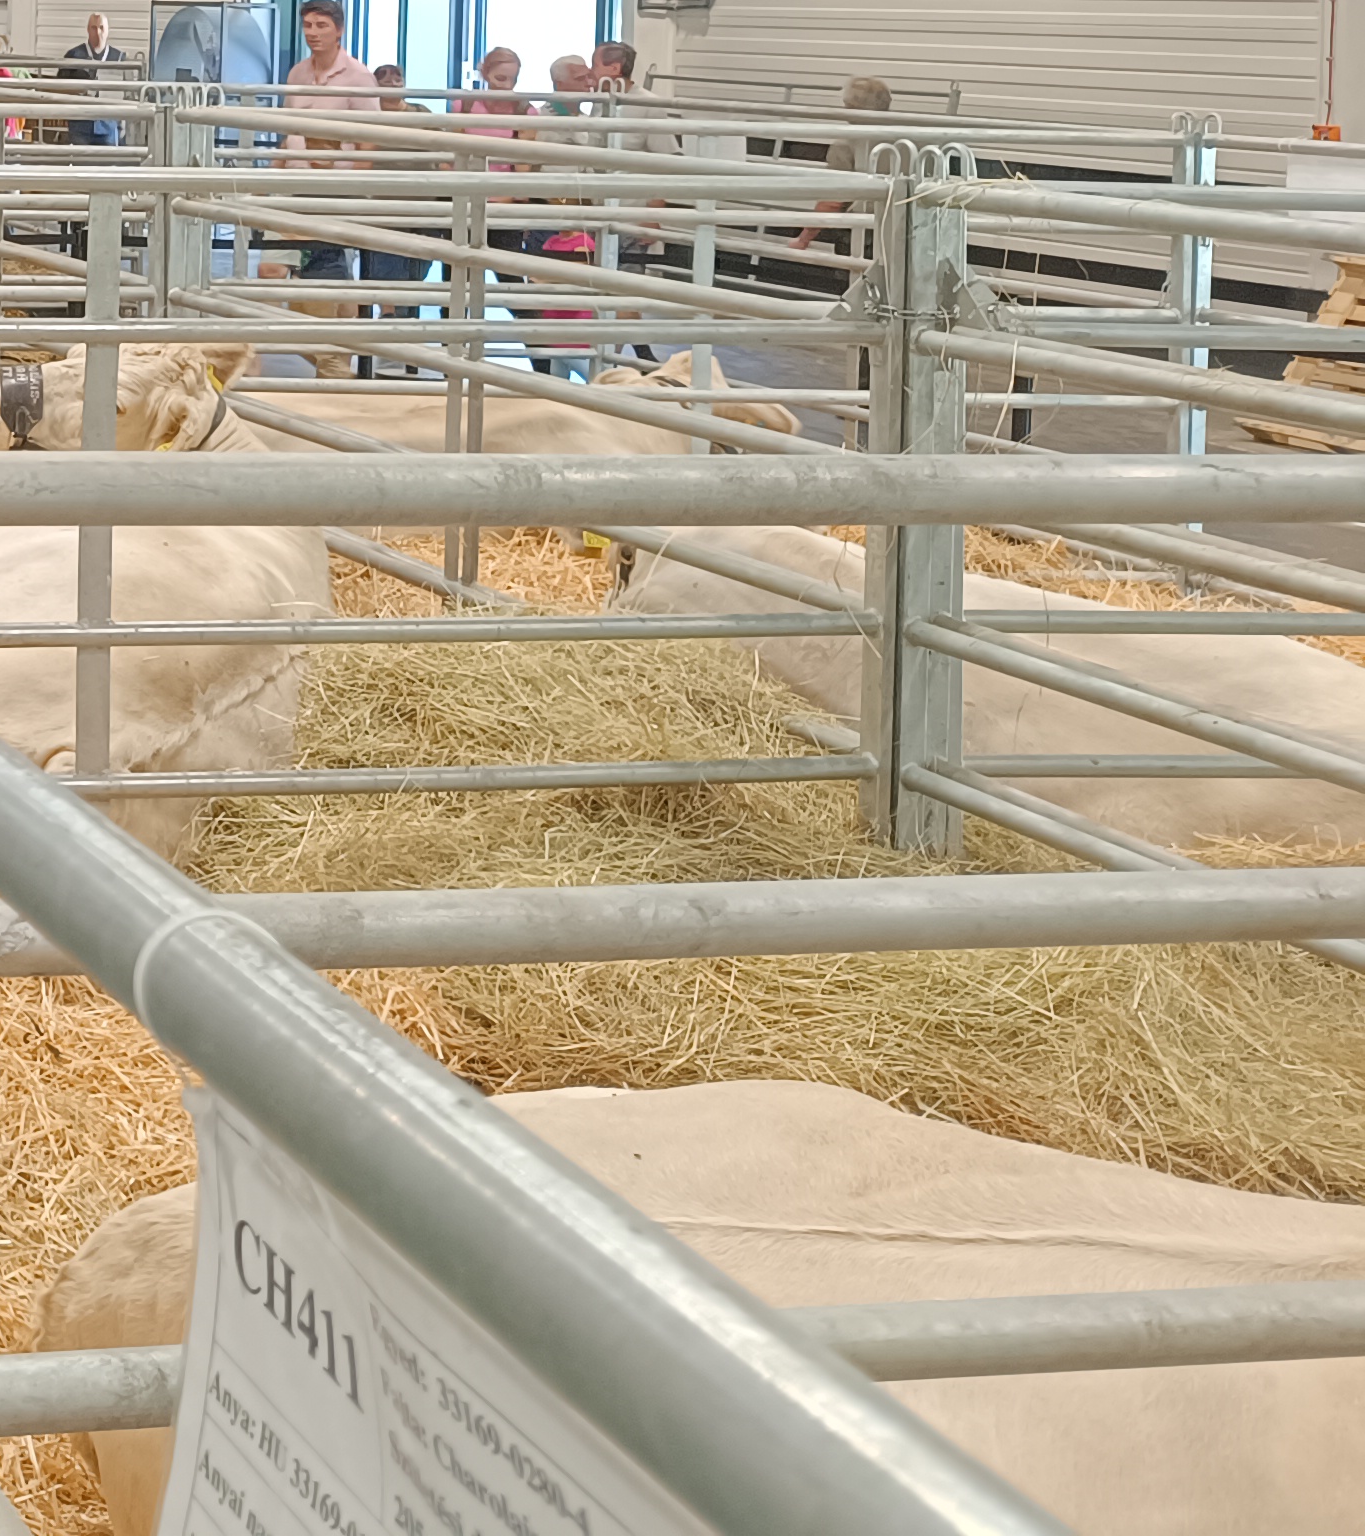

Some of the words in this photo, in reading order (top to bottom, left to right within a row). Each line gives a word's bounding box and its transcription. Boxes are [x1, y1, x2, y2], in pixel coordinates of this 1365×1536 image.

[234, 1219, 364, 1414] CH411
[198, 1447, 247, 1520] Anyai
[209, 1370, 257, 1440] Anya:
[258, 1419, 287, 1473] HU
[289, 1457, 365, 1536] 33169-0
